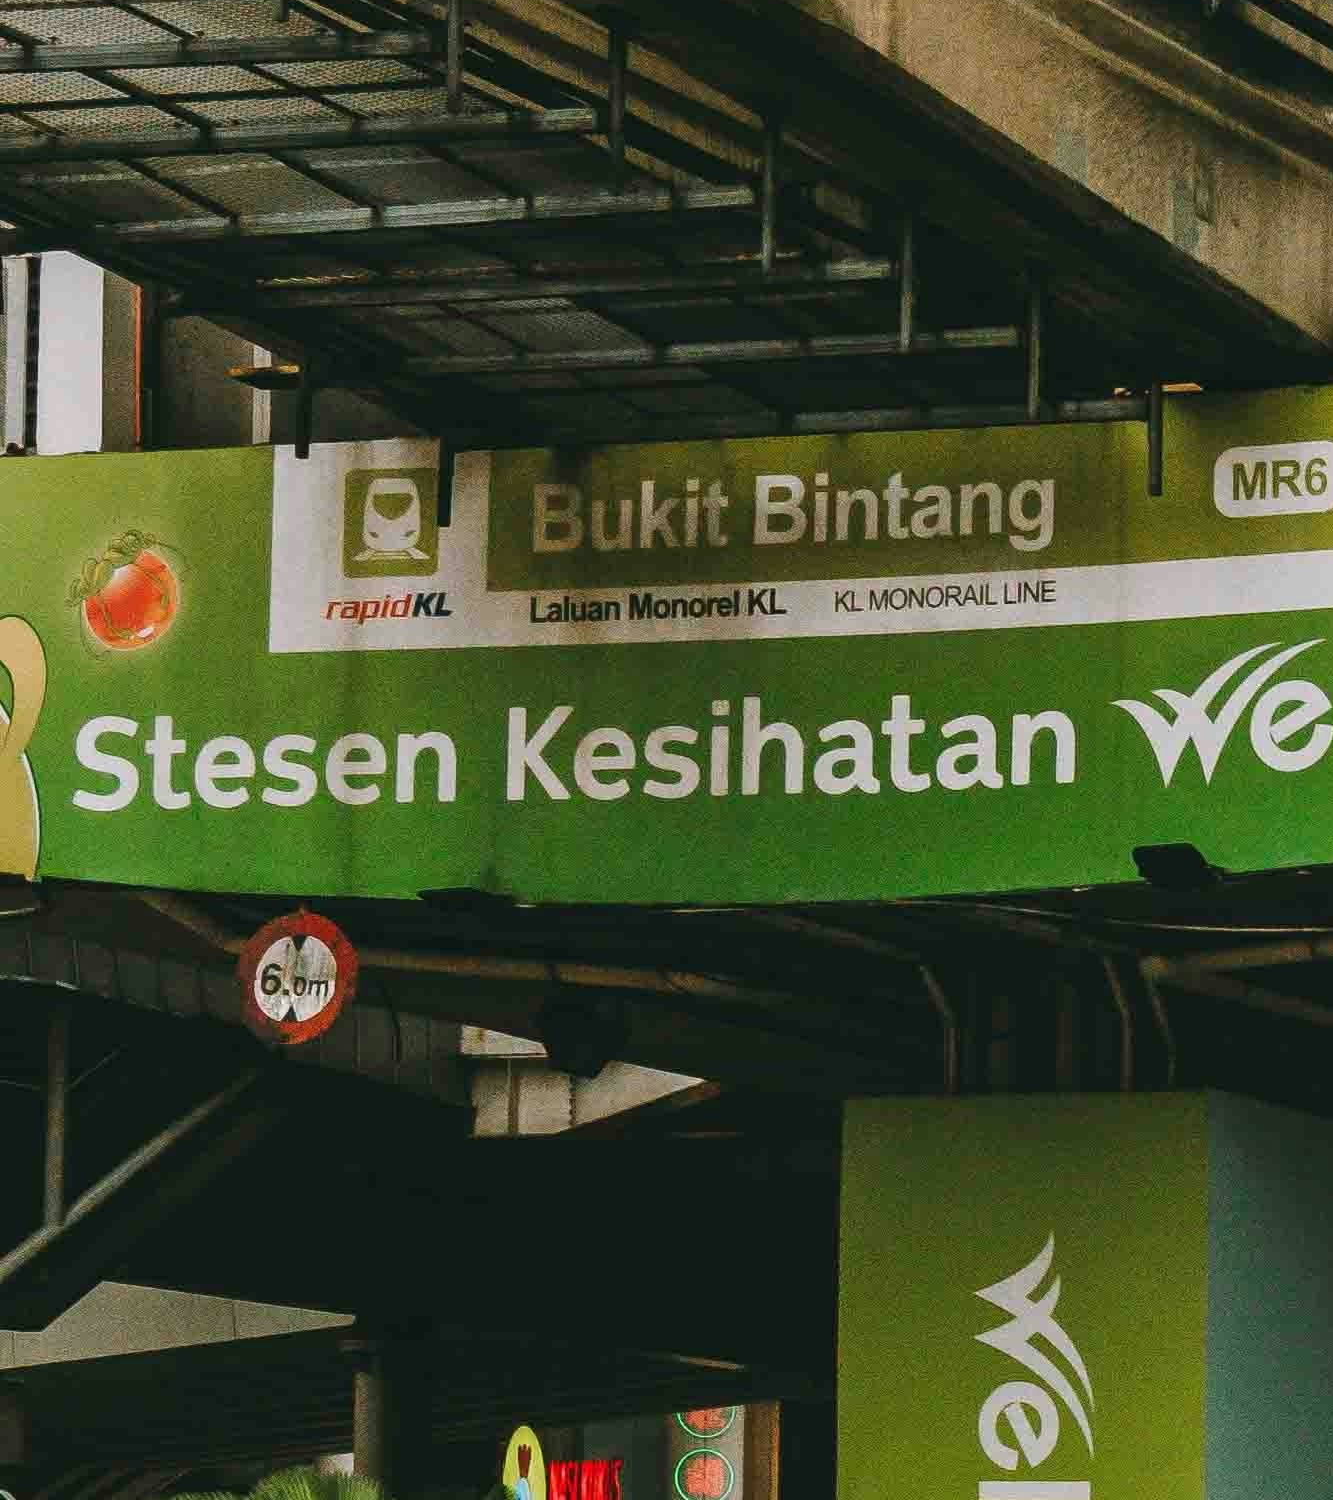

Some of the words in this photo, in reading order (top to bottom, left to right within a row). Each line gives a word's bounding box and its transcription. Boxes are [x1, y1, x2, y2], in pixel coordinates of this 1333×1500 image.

[1231, 457, 1329, 503] MR6
[531, 475, 729, 554] Bukit
[753, 472, 1056, 552] Bintang
[320, 590, 452, 626] rapidKL
[529, 595, 624, 625] Laluan
[627, 591, 741, 621] Monorel
[746, 589, 787, 616] KL
[833, 590, 864, 614] KL
[868, 584, 998, 612] MONORAIL
[1002, 580, 1057, 606] LINE
[73, 713, 458, 813] Stesen
[506, 694, 1077, 803] Kesihatan
